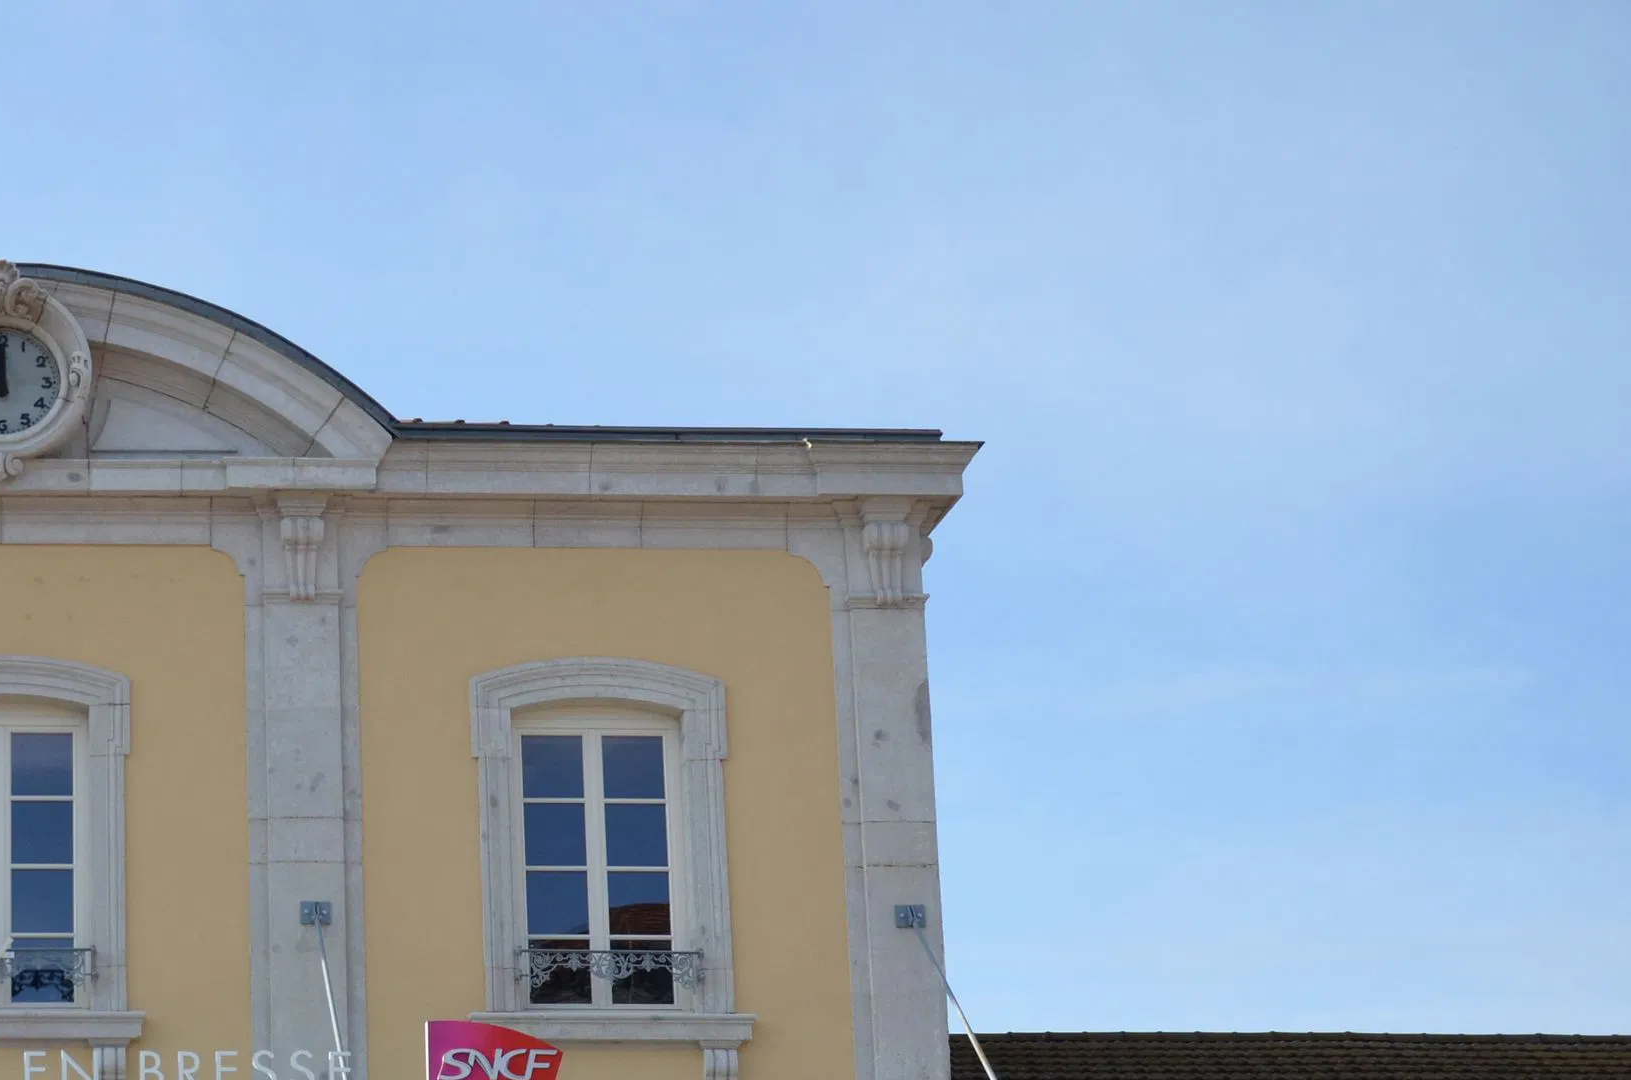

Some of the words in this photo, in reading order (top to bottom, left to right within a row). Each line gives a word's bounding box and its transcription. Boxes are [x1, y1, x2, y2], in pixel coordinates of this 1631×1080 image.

[21, 341, 26, 352] 1
[36, 356, 47, 367] 2
[41, 377, 52, 389] 3
[34, 398, 46, 409] 4
[20, 413, 30, 425] 5
